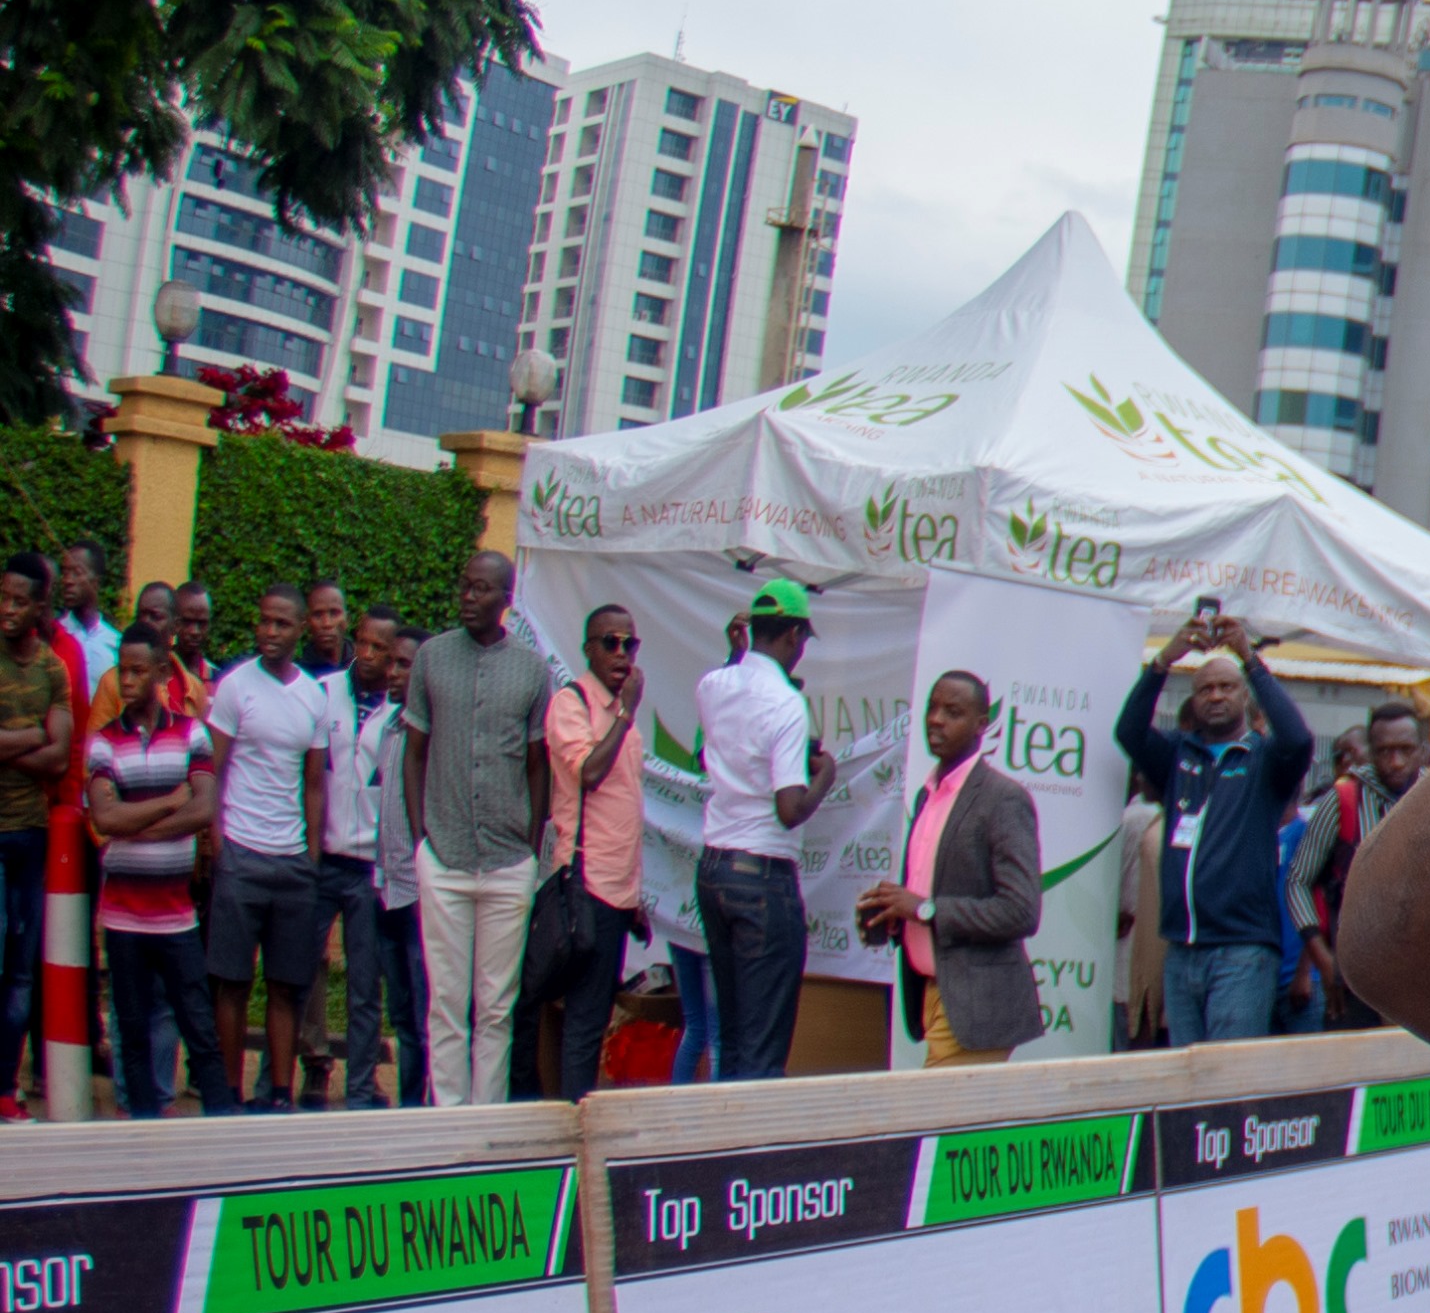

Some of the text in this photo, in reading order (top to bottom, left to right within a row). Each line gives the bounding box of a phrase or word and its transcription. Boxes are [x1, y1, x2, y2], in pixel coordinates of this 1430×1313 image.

[768, 98, 793, 123] EY
[880, 361, 1013, 385] RWANDA
[824, 386, 960, 426] tea
[555, 485, 603, 537] tea
[622, 505, 637, 527] A
[640, 499, 731, 525] NATURAL
[899, 499, 958, 563] tea
[1048, 521, 1122, 588] tea
[1141, 556, 1156, 581] A
[1163, 559, 1257, 590] NATURAL
[1010, 681, 1092, 713] RWANDA
[1005, 704, 1085, 779] tea
[1195, 1113, 1320, 1168] Top Sponsor
[1371, 1096, 1406, 1138] TOUR
[1408, 1091, 1427, 1128] DU
[945, 1129, 1117, 1205] TOUR DU RWANDA
[644, 1176, 854, 1250] Top Sponsor
[242, 1188, 532, 1293] TOUR DU RWANDA
